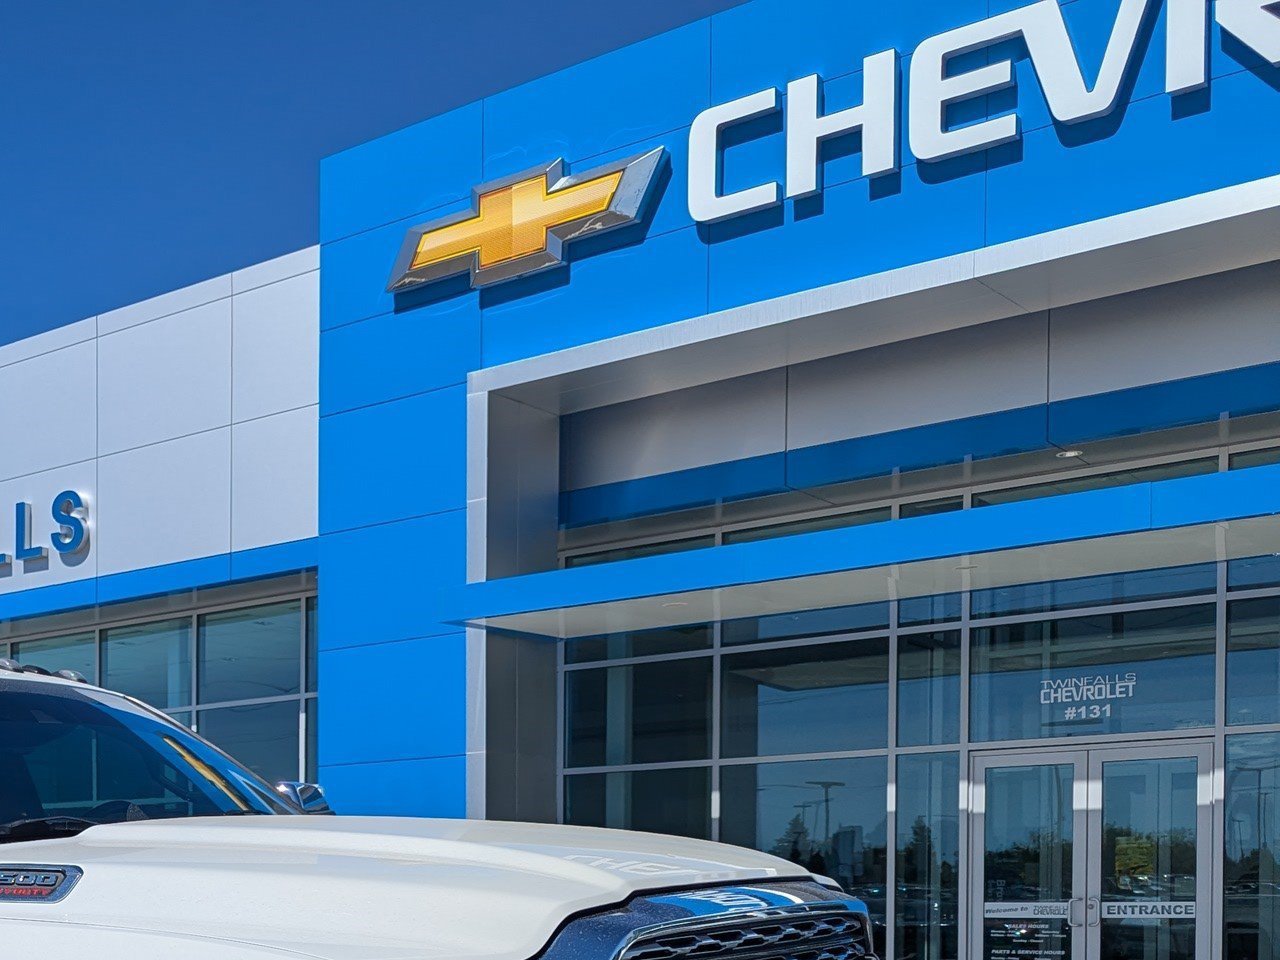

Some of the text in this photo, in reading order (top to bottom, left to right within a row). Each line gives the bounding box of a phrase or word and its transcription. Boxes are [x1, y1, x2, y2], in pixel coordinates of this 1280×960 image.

[1040, 682, 1136, 704] CHEVROLET
[1064, 704, 1111, 720] #131
[1106, 904, 1195, 915] ENTRANCE
